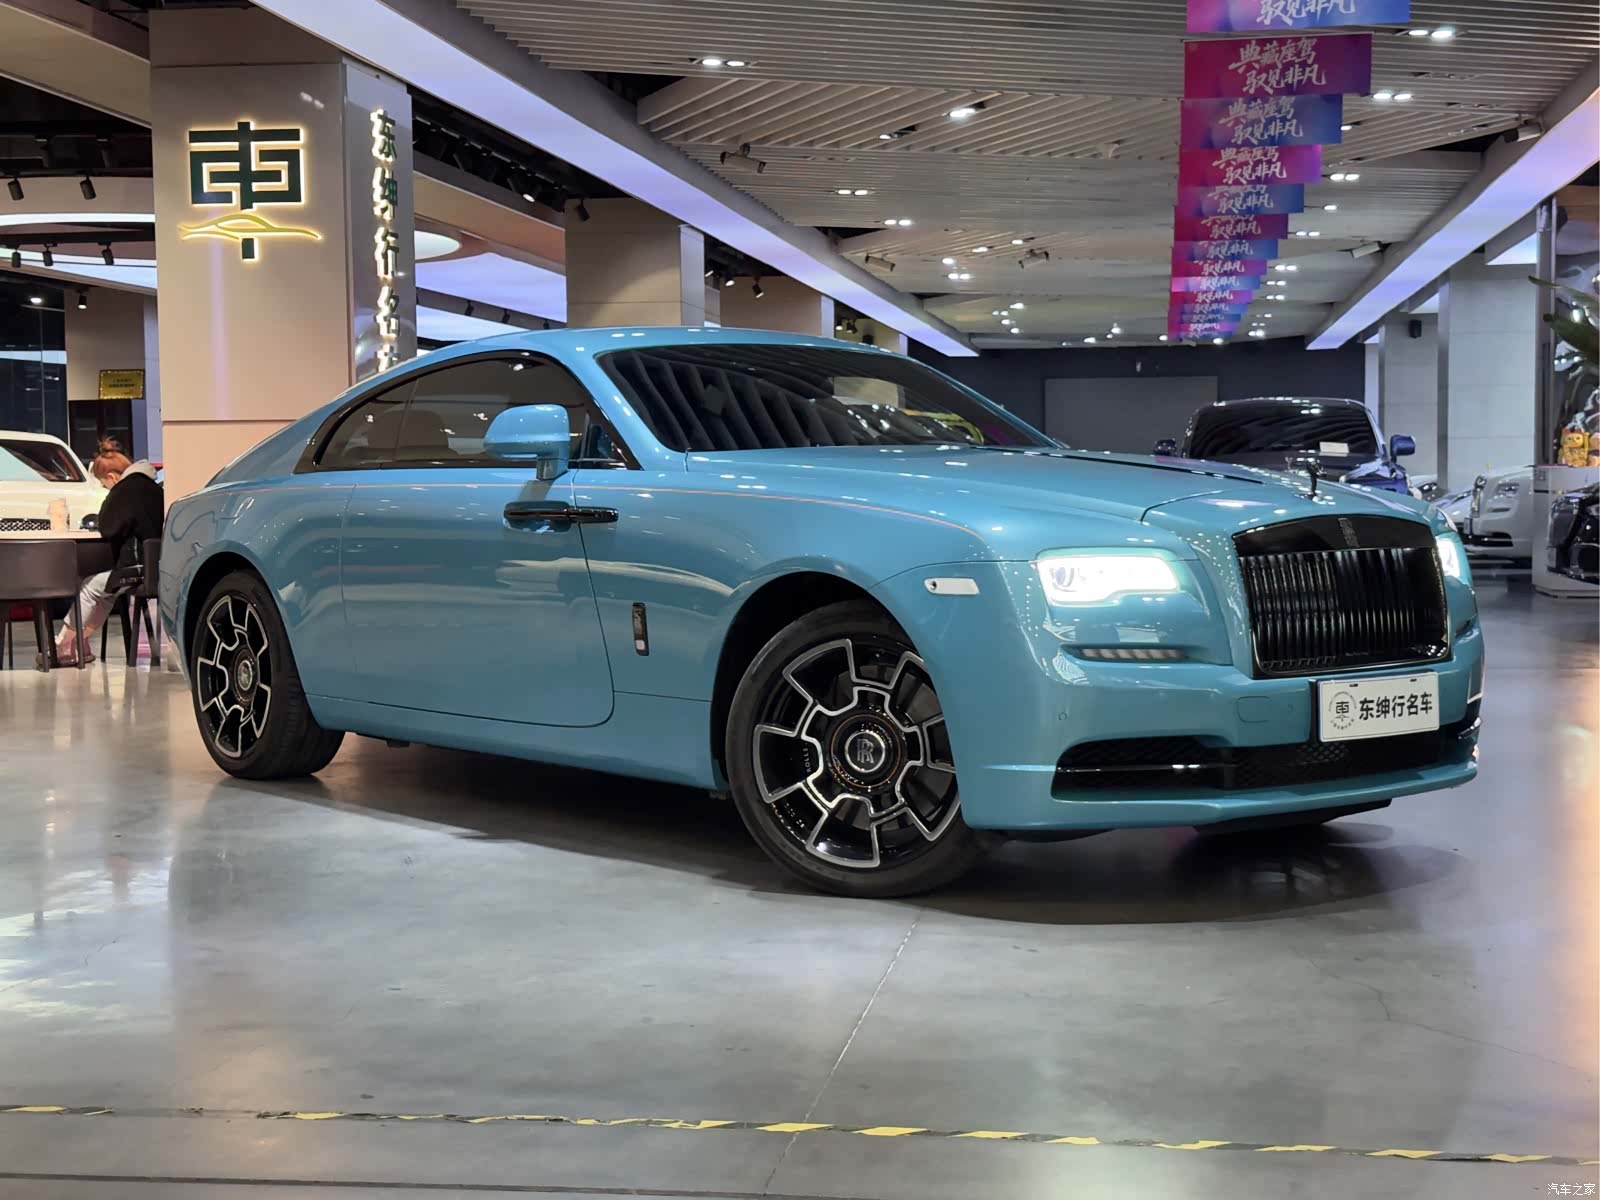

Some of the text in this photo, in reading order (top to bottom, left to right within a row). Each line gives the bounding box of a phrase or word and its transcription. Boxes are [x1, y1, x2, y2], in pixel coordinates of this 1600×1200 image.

[1228, 37, 1318, 74] 典藏座驾
[1242, 64, 1327, 95] 驭见非凡
[1231, 119, 1304, 145] 驭见非凡
[1222, 161, 1287, 184] 驭见非凡
[1359, 691, 1433, 721] 东绅行名车
